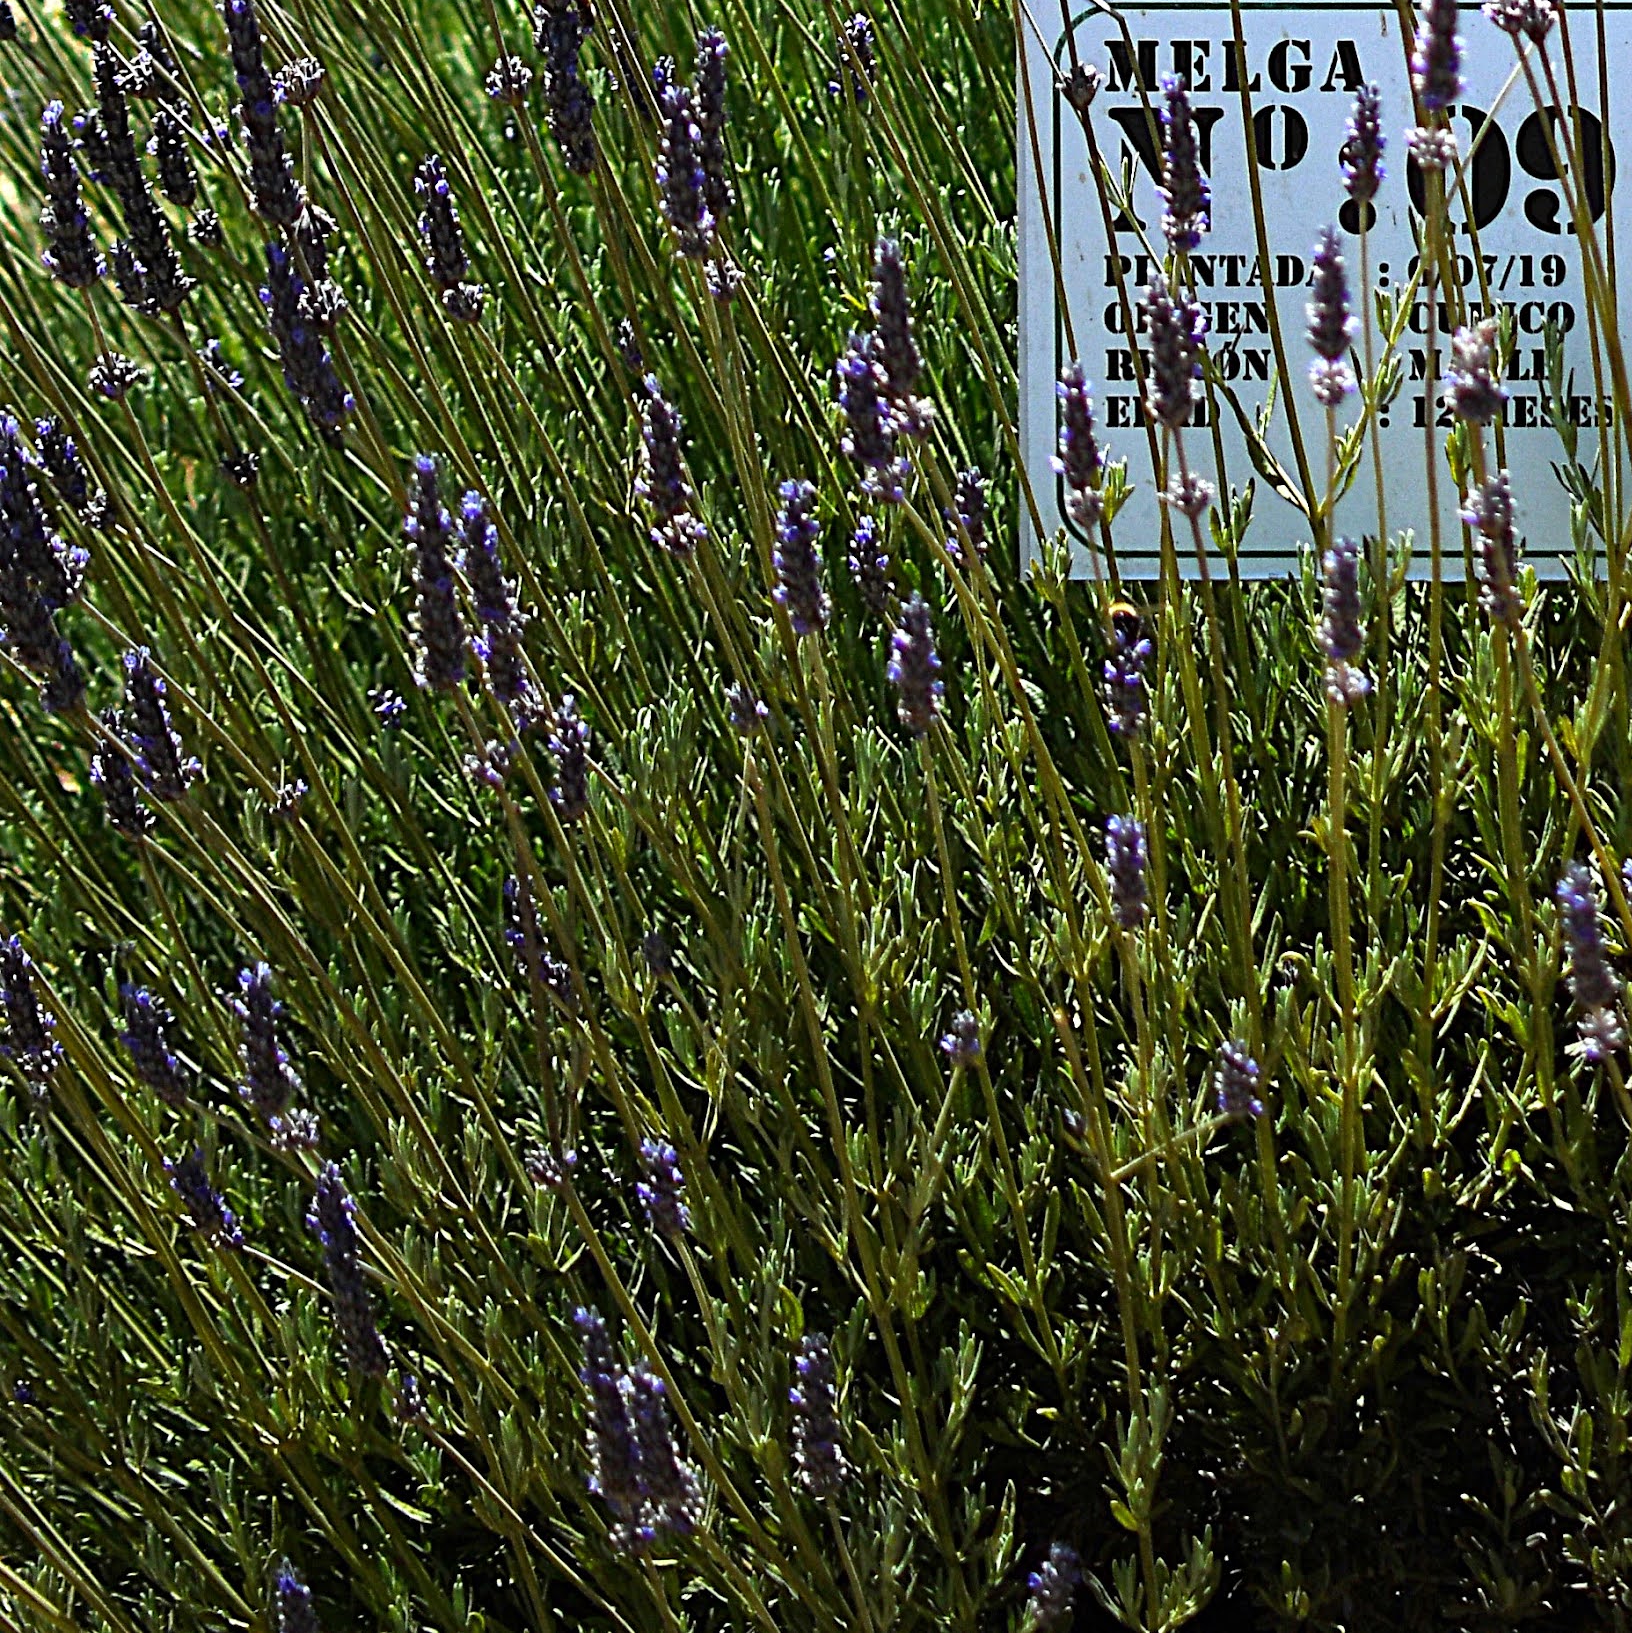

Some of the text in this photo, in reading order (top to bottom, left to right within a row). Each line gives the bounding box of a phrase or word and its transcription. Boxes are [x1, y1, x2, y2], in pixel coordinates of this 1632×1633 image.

[1104, 39, 1364, 93] MELGA
[1406, 104, 1616, 235] 09
[1104, 255, 1322, 287] PLNTAD
